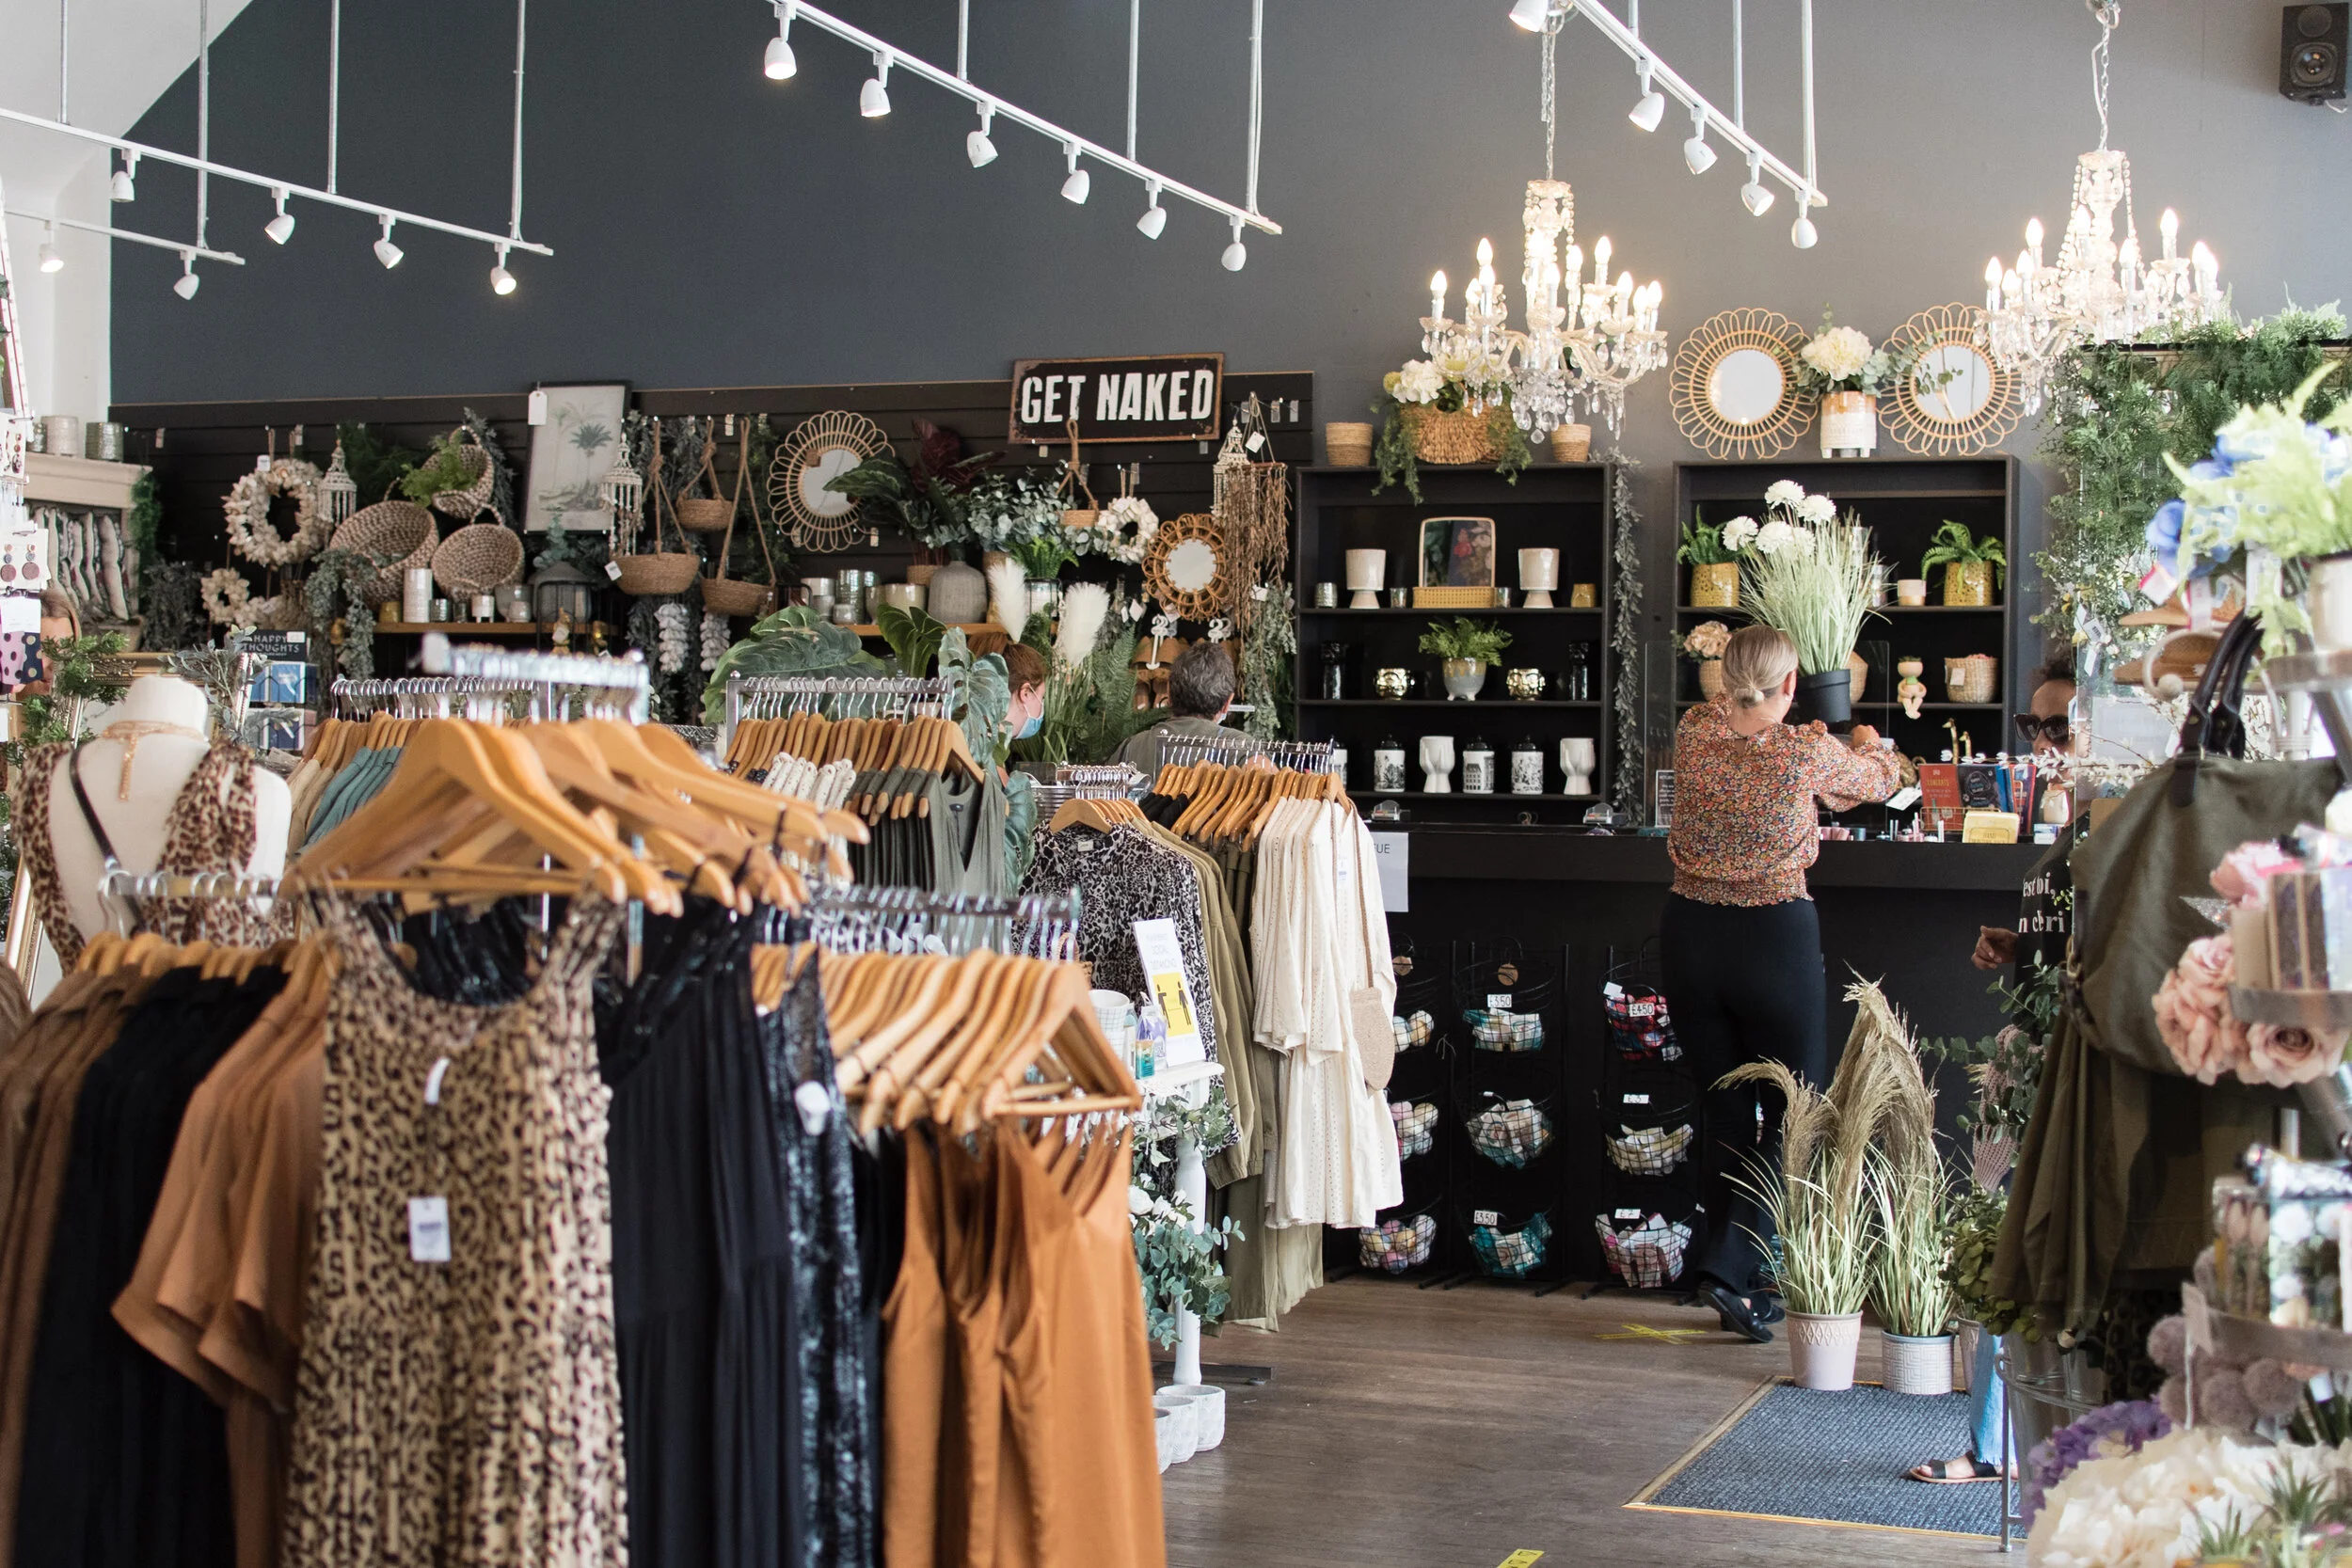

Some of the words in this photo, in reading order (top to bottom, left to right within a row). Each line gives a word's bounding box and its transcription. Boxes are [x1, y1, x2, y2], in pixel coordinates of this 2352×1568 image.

[1021, 374, 1087, 424] GET
[1095, 369, 1215, 421] NAKED
[253, 634, 287, 643] HAPPY
[243, 642, 300, 653] THOUGHTS
[1374, 843, 1391, 854] UE
